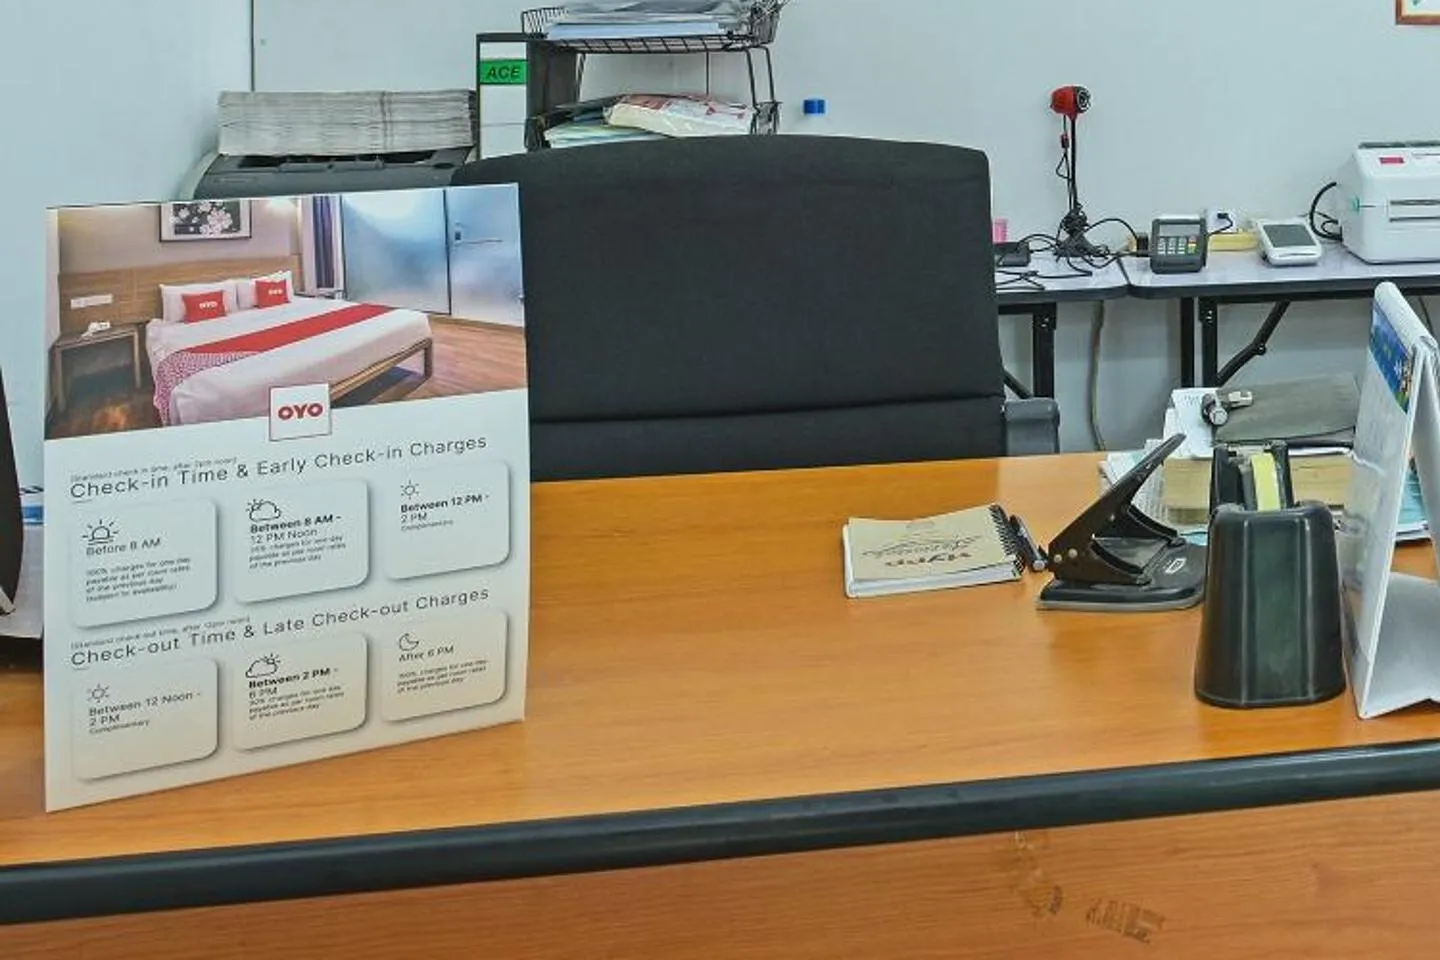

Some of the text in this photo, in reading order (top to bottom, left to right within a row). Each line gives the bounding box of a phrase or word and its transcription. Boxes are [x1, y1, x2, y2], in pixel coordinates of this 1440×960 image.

[485, 65, 521, 81] ACE
[277, 401, 325, 421] OYO
[70, 437, 486, 498] Check-in Time & Early Check-in Charges
[400, 500, 448, 513] Between
[451, 497, 461, 506] 12
[465, 494, 482, 505] PM
[250, 520, 301, 533] Between
[304, 517, 311, 526] 8
[314, 514, 333, 524] AM
[401, 512, 427, 523] 2 PM
[266, 532, 286, 542] PM
[287, 529, 317, 539] Noon
[86, 544, 126, 556] Before
[143, 538, 161, 548] AM
[71, 588, 489, 666] Check-out Time & Late Check-out Charges
[399, 651, 424, 663] After
[436, 645, 454, 656] PM
[249, 673, 300, 688] Between
[302, 671, 310, 681] 2
[312, 667, 330, 677] PM
[89, 701, 141, 717] Between
[146, 698, 158, 707] 12
[162, 692, 193, 704] Noon
[89, 714, 120, 726] 2 PM
